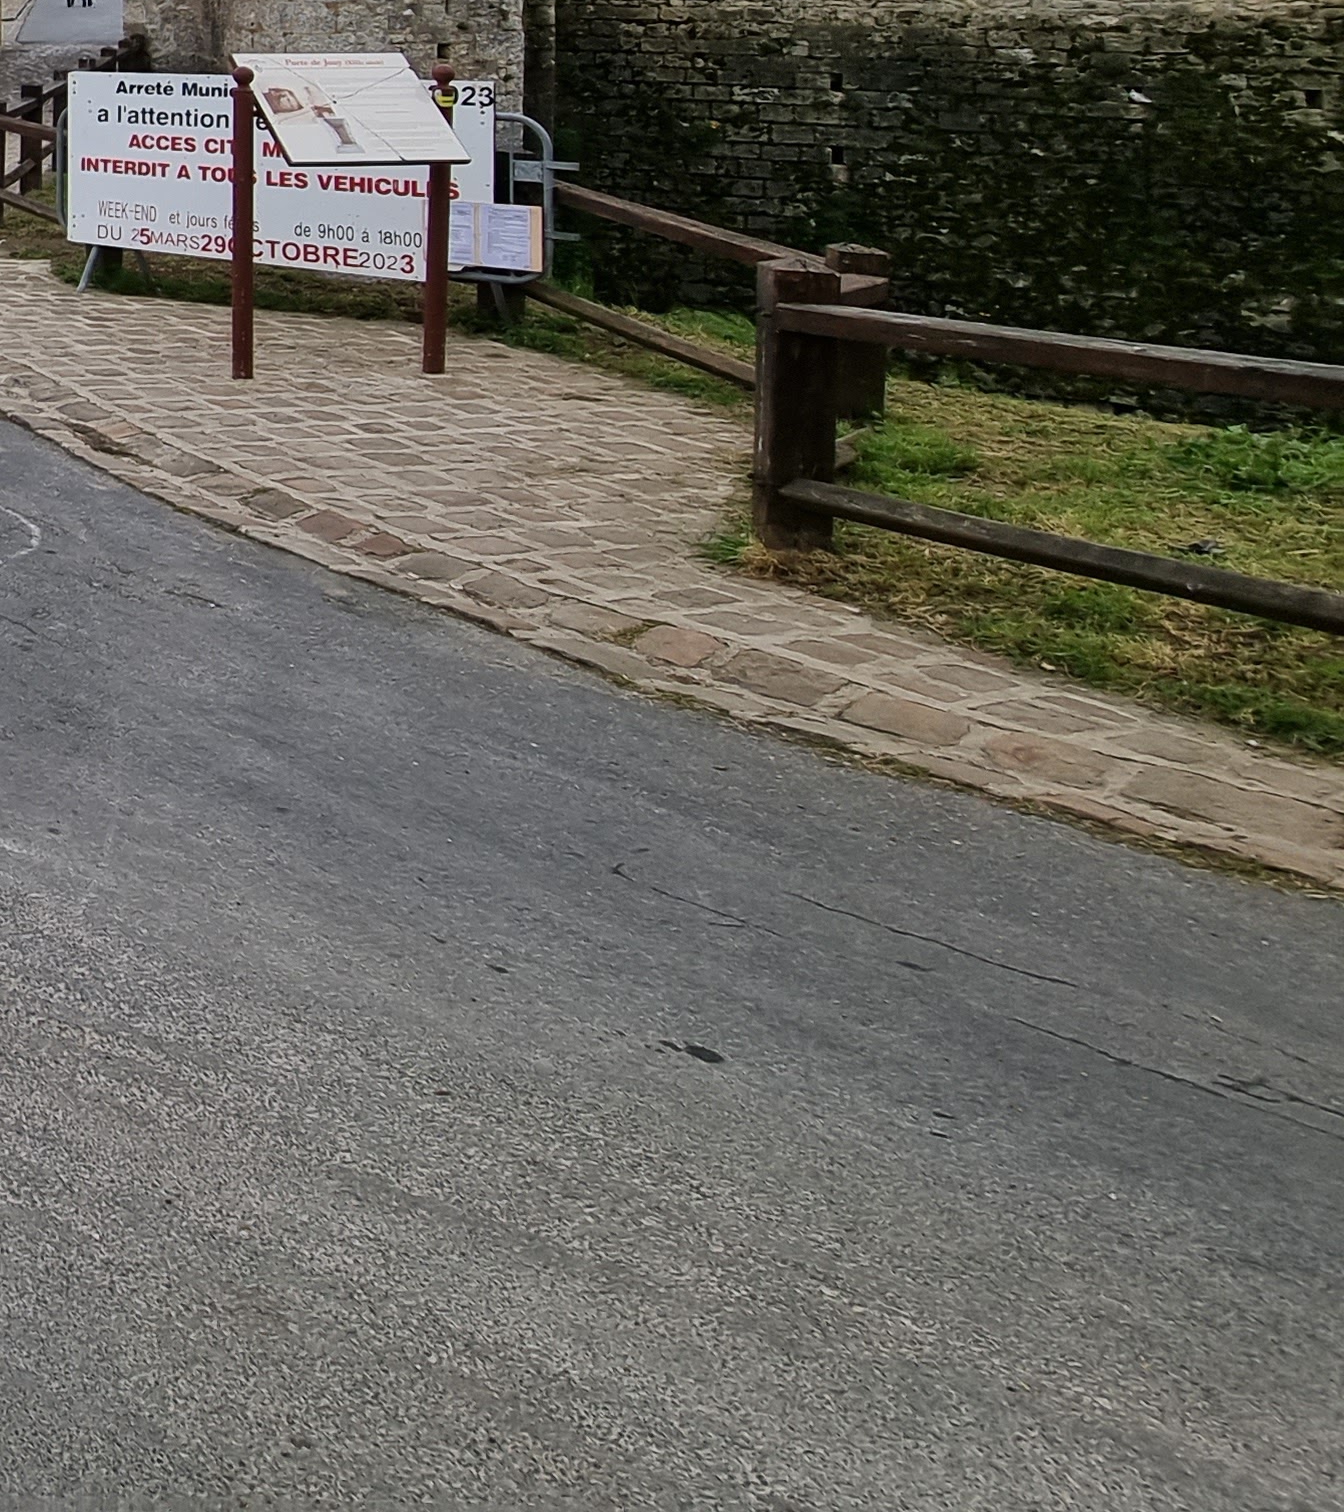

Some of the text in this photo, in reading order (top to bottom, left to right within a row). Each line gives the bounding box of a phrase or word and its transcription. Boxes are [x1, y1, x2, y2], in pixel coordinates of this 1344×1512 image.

[116, 80, 174, 96] Arreté
[97, 108, 109, 123] a
[117, 105, 230, 129] l'attention
[128, 134, 197, 153] ACCES
[81, 157, 170, 178] INTERDIT
[176, 164, 191, 180] A
[266, 170, 309, 189] LES
[97, 224, 122, 241] DU
[98, 200, 157, 223] WEEK-END
[169, 210, 181, 225] et
[186, 211, 218, 229] jours
[294, 222, 311, 238] de
[318, 223, 355, 242] 9h00
[378, 229, 423, 248] 18h00
